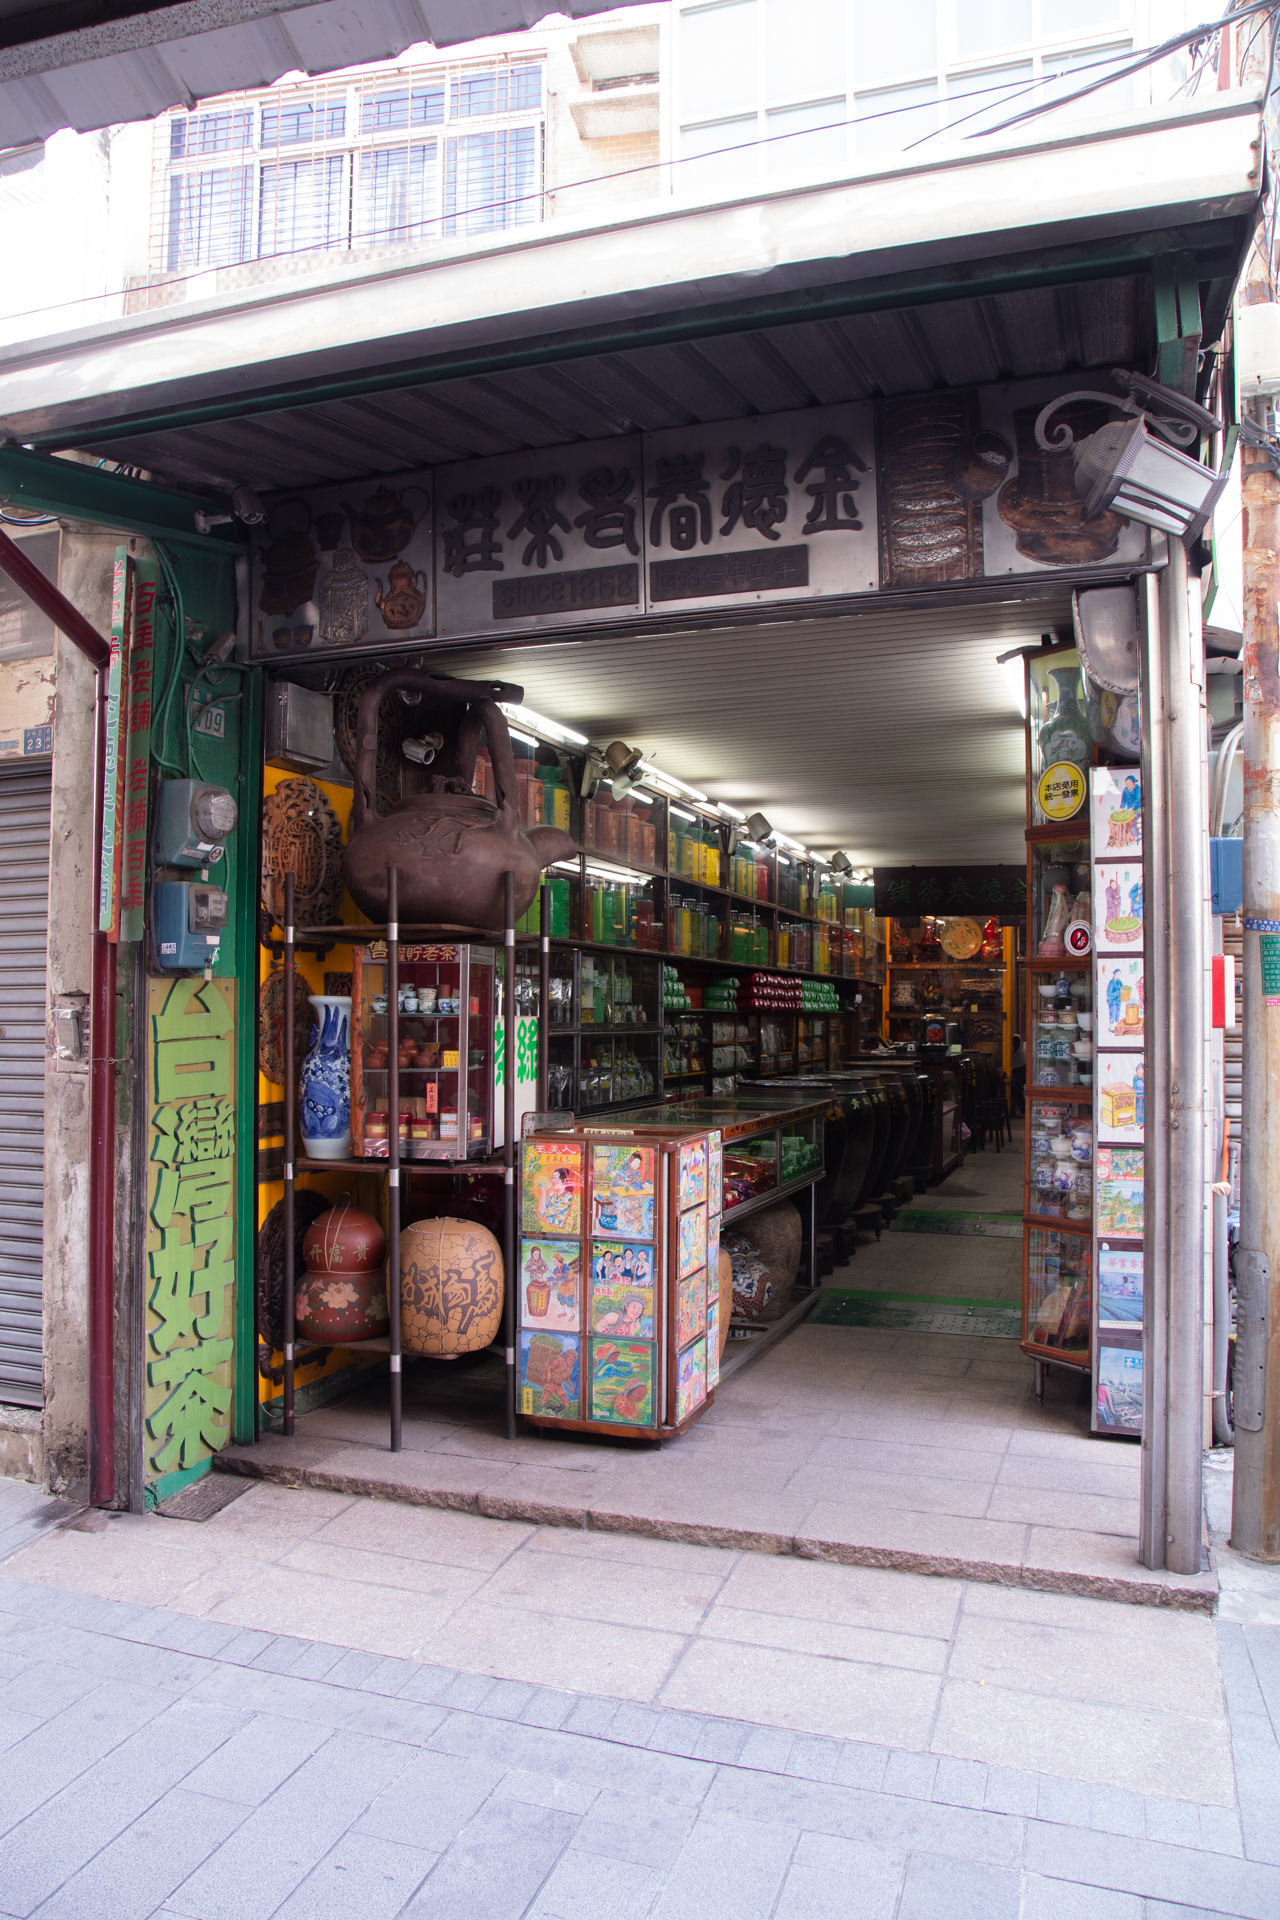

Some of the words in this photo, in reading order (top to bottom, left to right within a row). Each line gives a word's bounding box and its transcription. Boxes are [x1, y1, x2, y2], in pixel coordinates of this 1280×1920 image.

[27, 737, 42, 750] 23
[1044, 779, 1079, 792] 本店免用
[1044, 789, 1079, 801] 統一發票
[146, 978, 236, 1472] 台灣好茶
